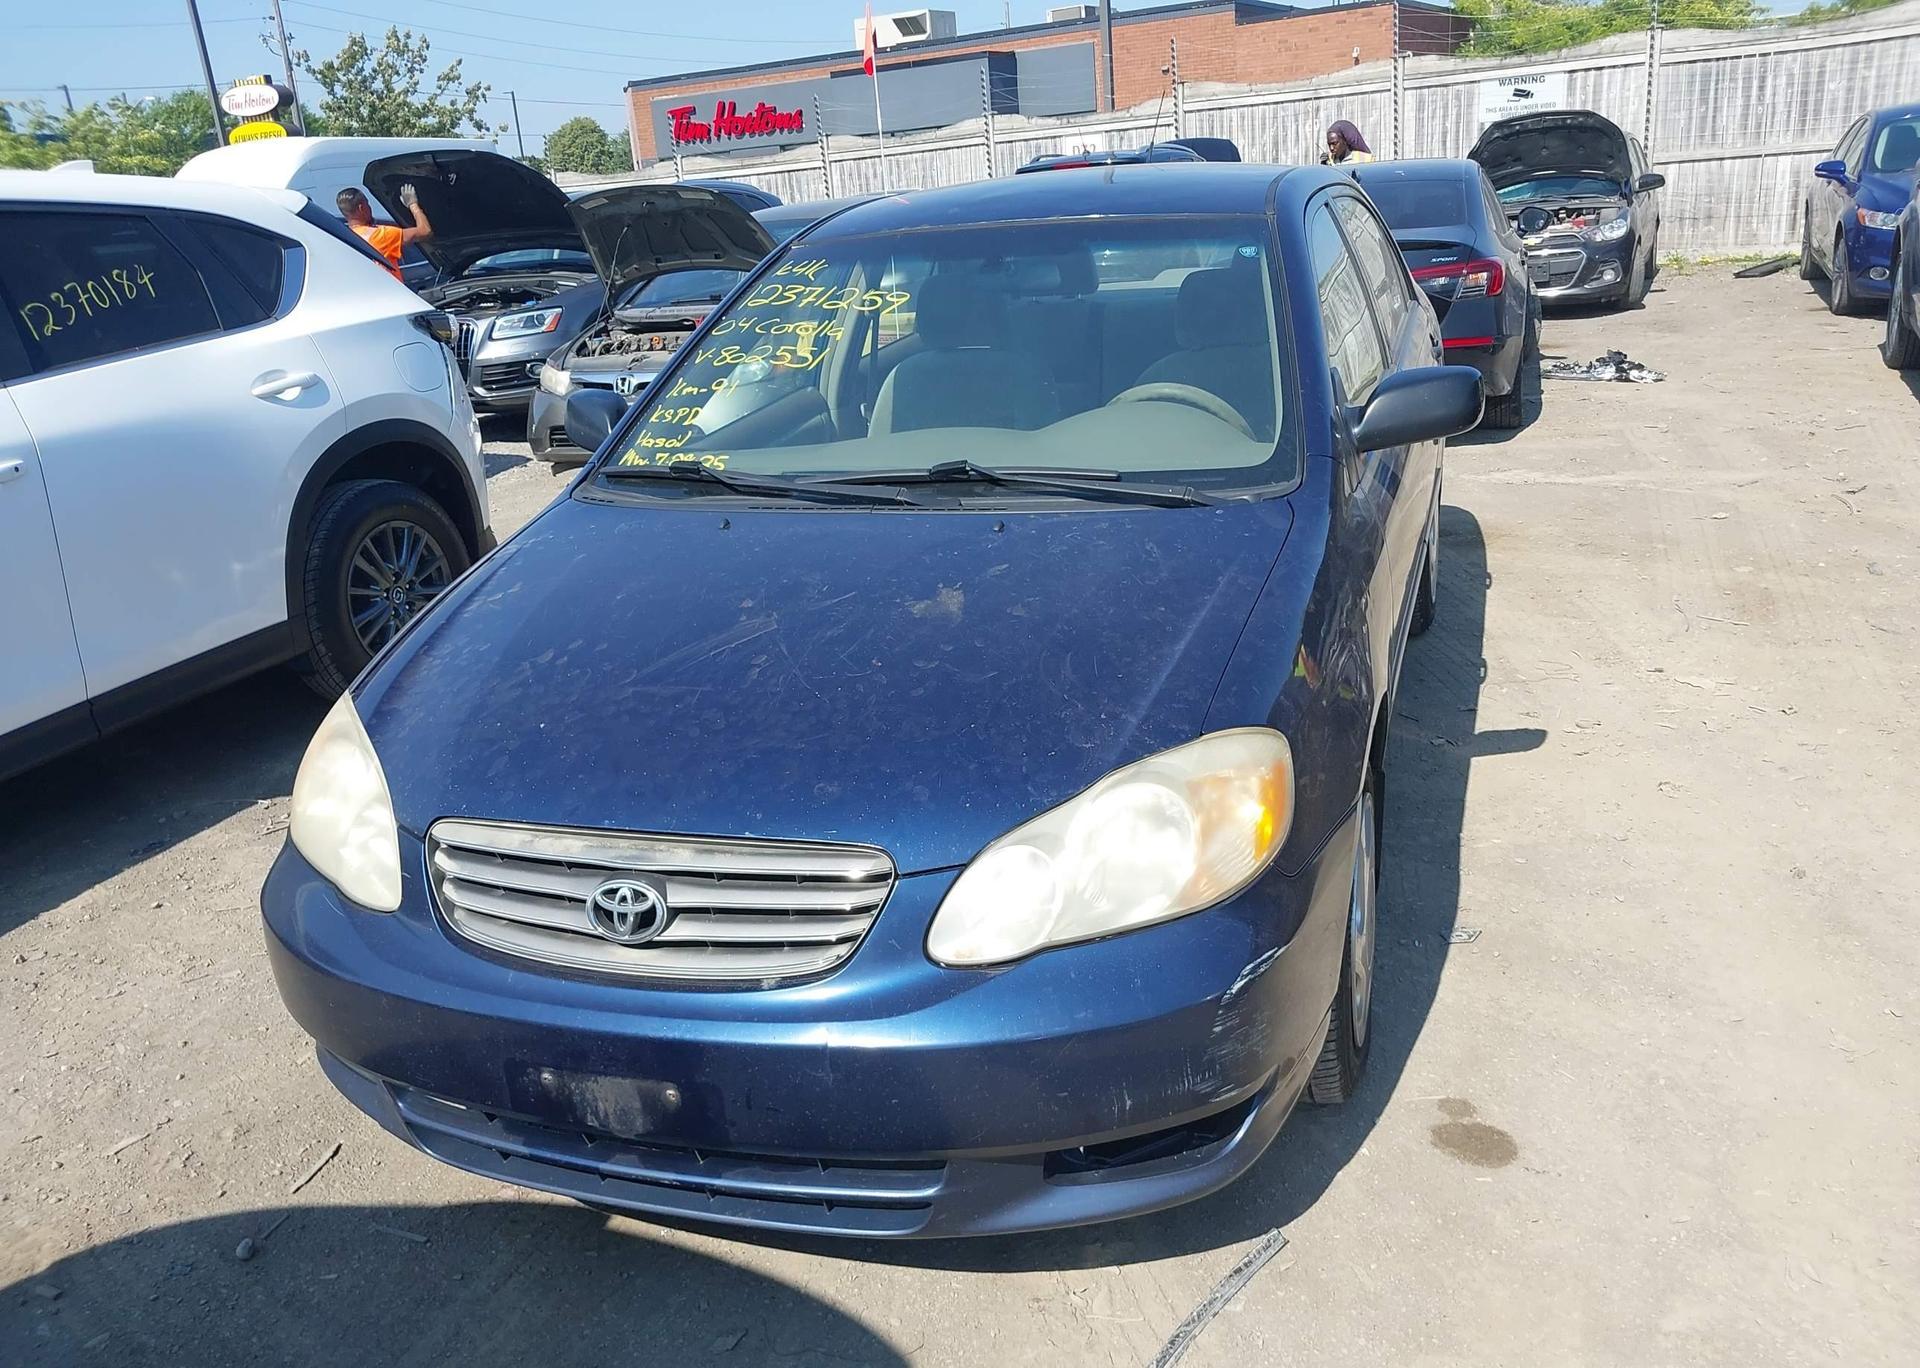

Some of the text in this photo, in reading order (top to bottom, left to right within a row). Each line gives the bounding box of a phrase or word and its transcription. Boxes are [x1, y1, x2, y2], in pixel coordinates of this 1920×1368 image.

[1498, 75, 1546, 87] WARNING
[1498, 105, 1513, 113] AREA
[1520, 103, 1539, 111] UNDER
[666, 100, 804, 144] Tim Hortons
[260, 130, 282, 140] FRESH
[19, 264, 156, 341] 12370184
[738, 284, 911, 314] 12371259
